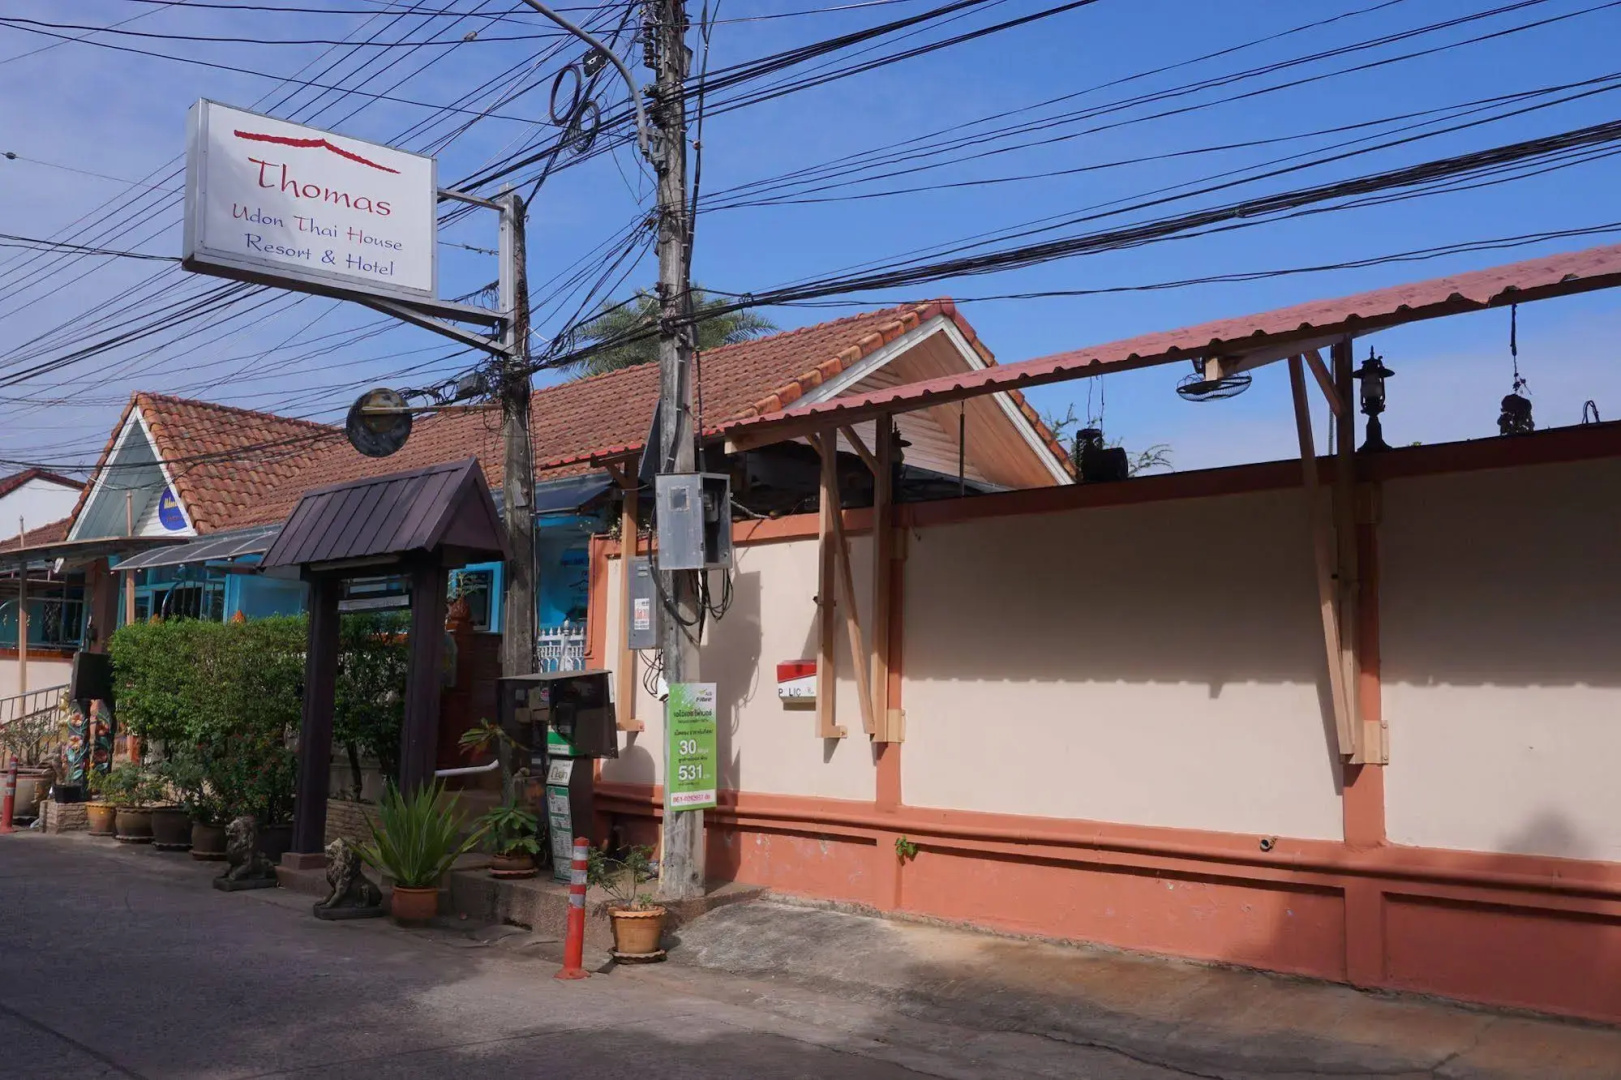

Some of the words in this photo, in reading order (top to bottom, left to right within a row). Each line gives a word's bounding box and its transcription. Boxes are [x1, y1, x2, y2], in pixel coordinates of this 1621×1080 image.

[248, 157, 391, 216] Thomas
[232, 203, 284, 228] Udon
[294, 215, 338, 238] Thai
[347, 226, 403, 251] House
[244, 233, 312, 260] Resort
[321, 249, 336, 265] &
[346, 254, 394, 276] Hotel
[679, 739, 697, 755] 30
[678, 764, 703, 780] 531
